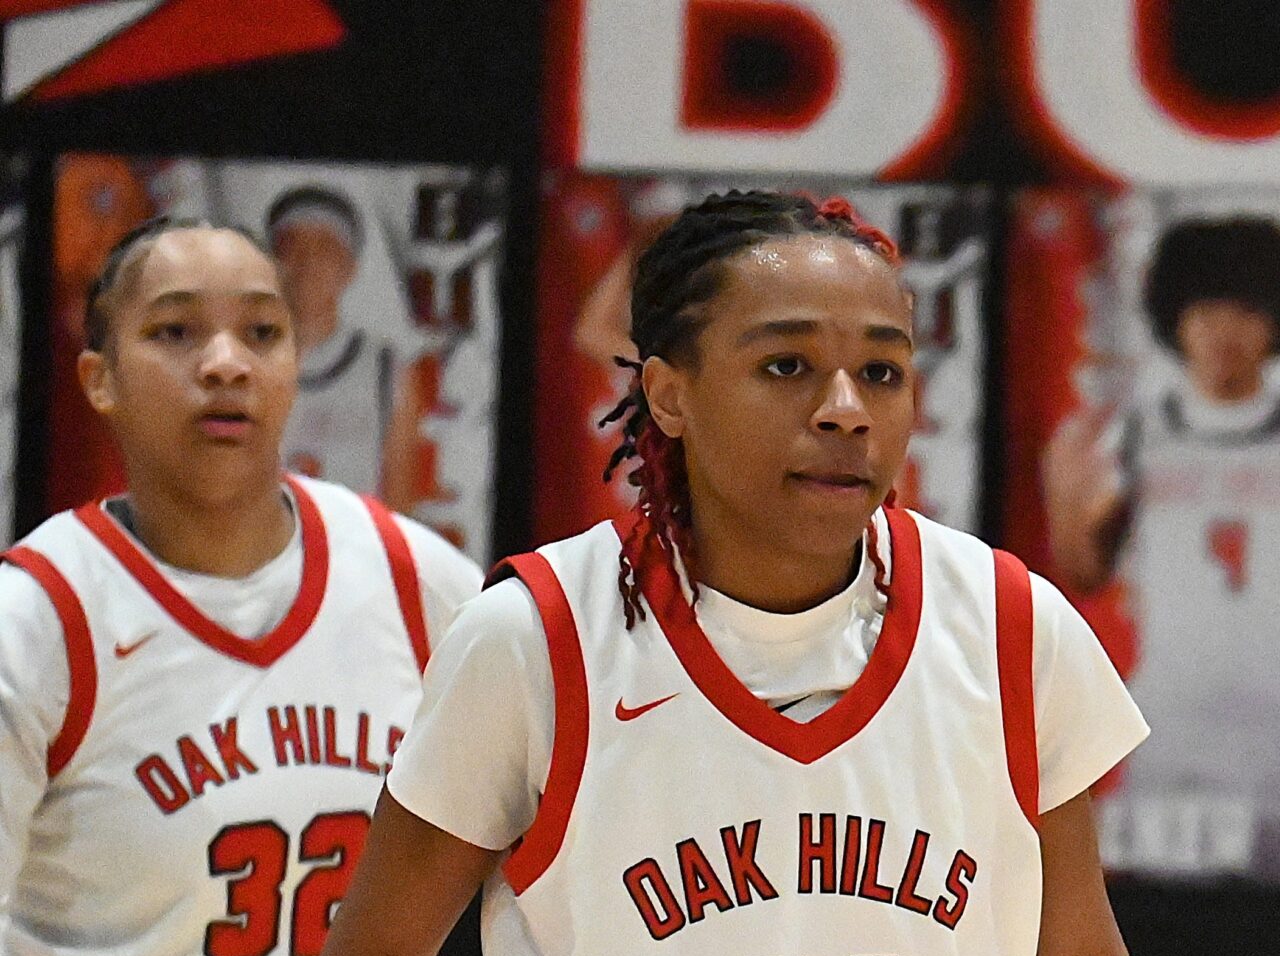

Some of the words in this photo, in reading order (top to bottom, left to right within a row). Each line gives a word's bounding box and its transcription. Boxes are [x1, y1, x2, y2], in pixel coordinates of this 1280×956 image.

[134, 715, 259, 816] OAK
[623, 819, 780, 941] OAK
[798, 812, 977, 931] HILLS
